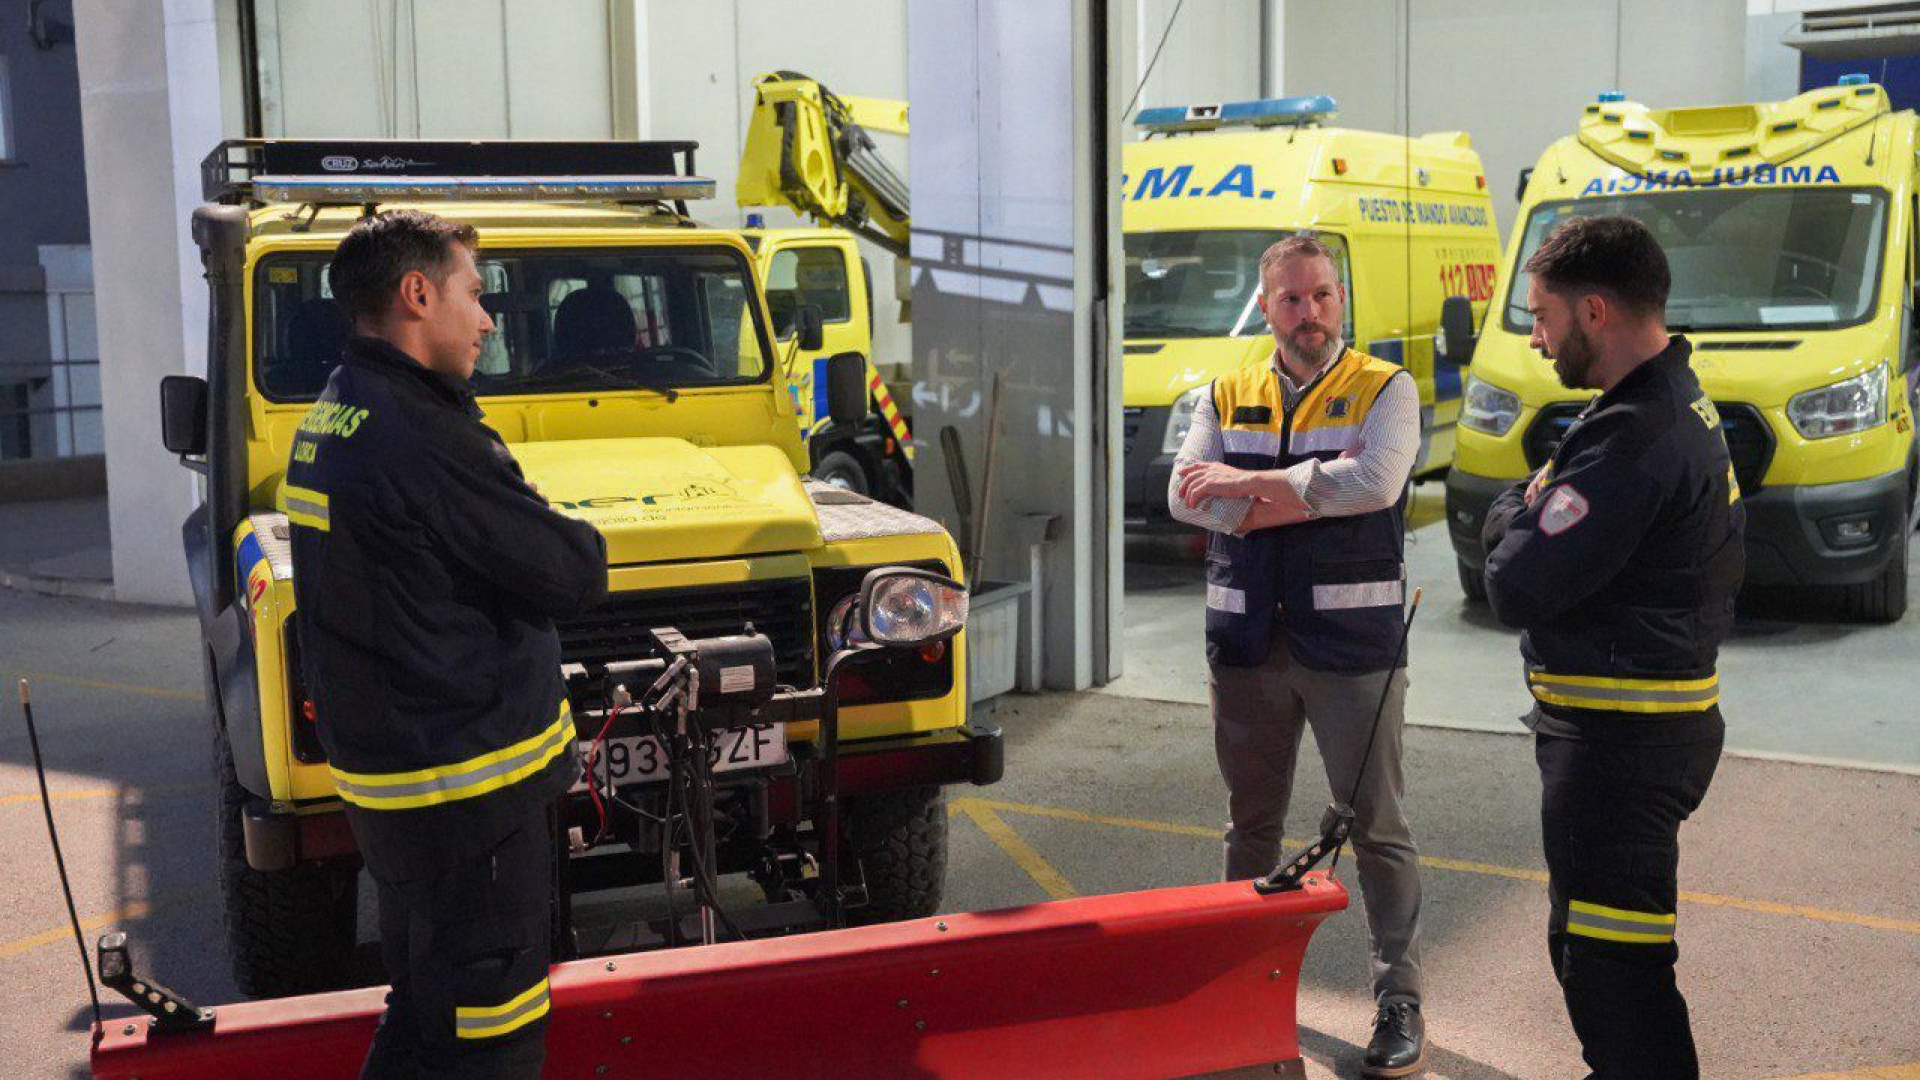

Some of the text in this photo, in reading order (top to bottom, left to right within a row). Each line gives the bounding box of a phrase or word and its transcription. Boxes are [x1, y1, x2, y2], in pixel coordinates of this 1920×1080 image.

[323, 157, 358, 170] CRUZ
[1122, 164, 1275, 200] M.A.
[1359, 197, 1400, 222] PUESTO
[1402, 200, 1415, 224] DE
[1417, 202, 1446, 225] MANDO
